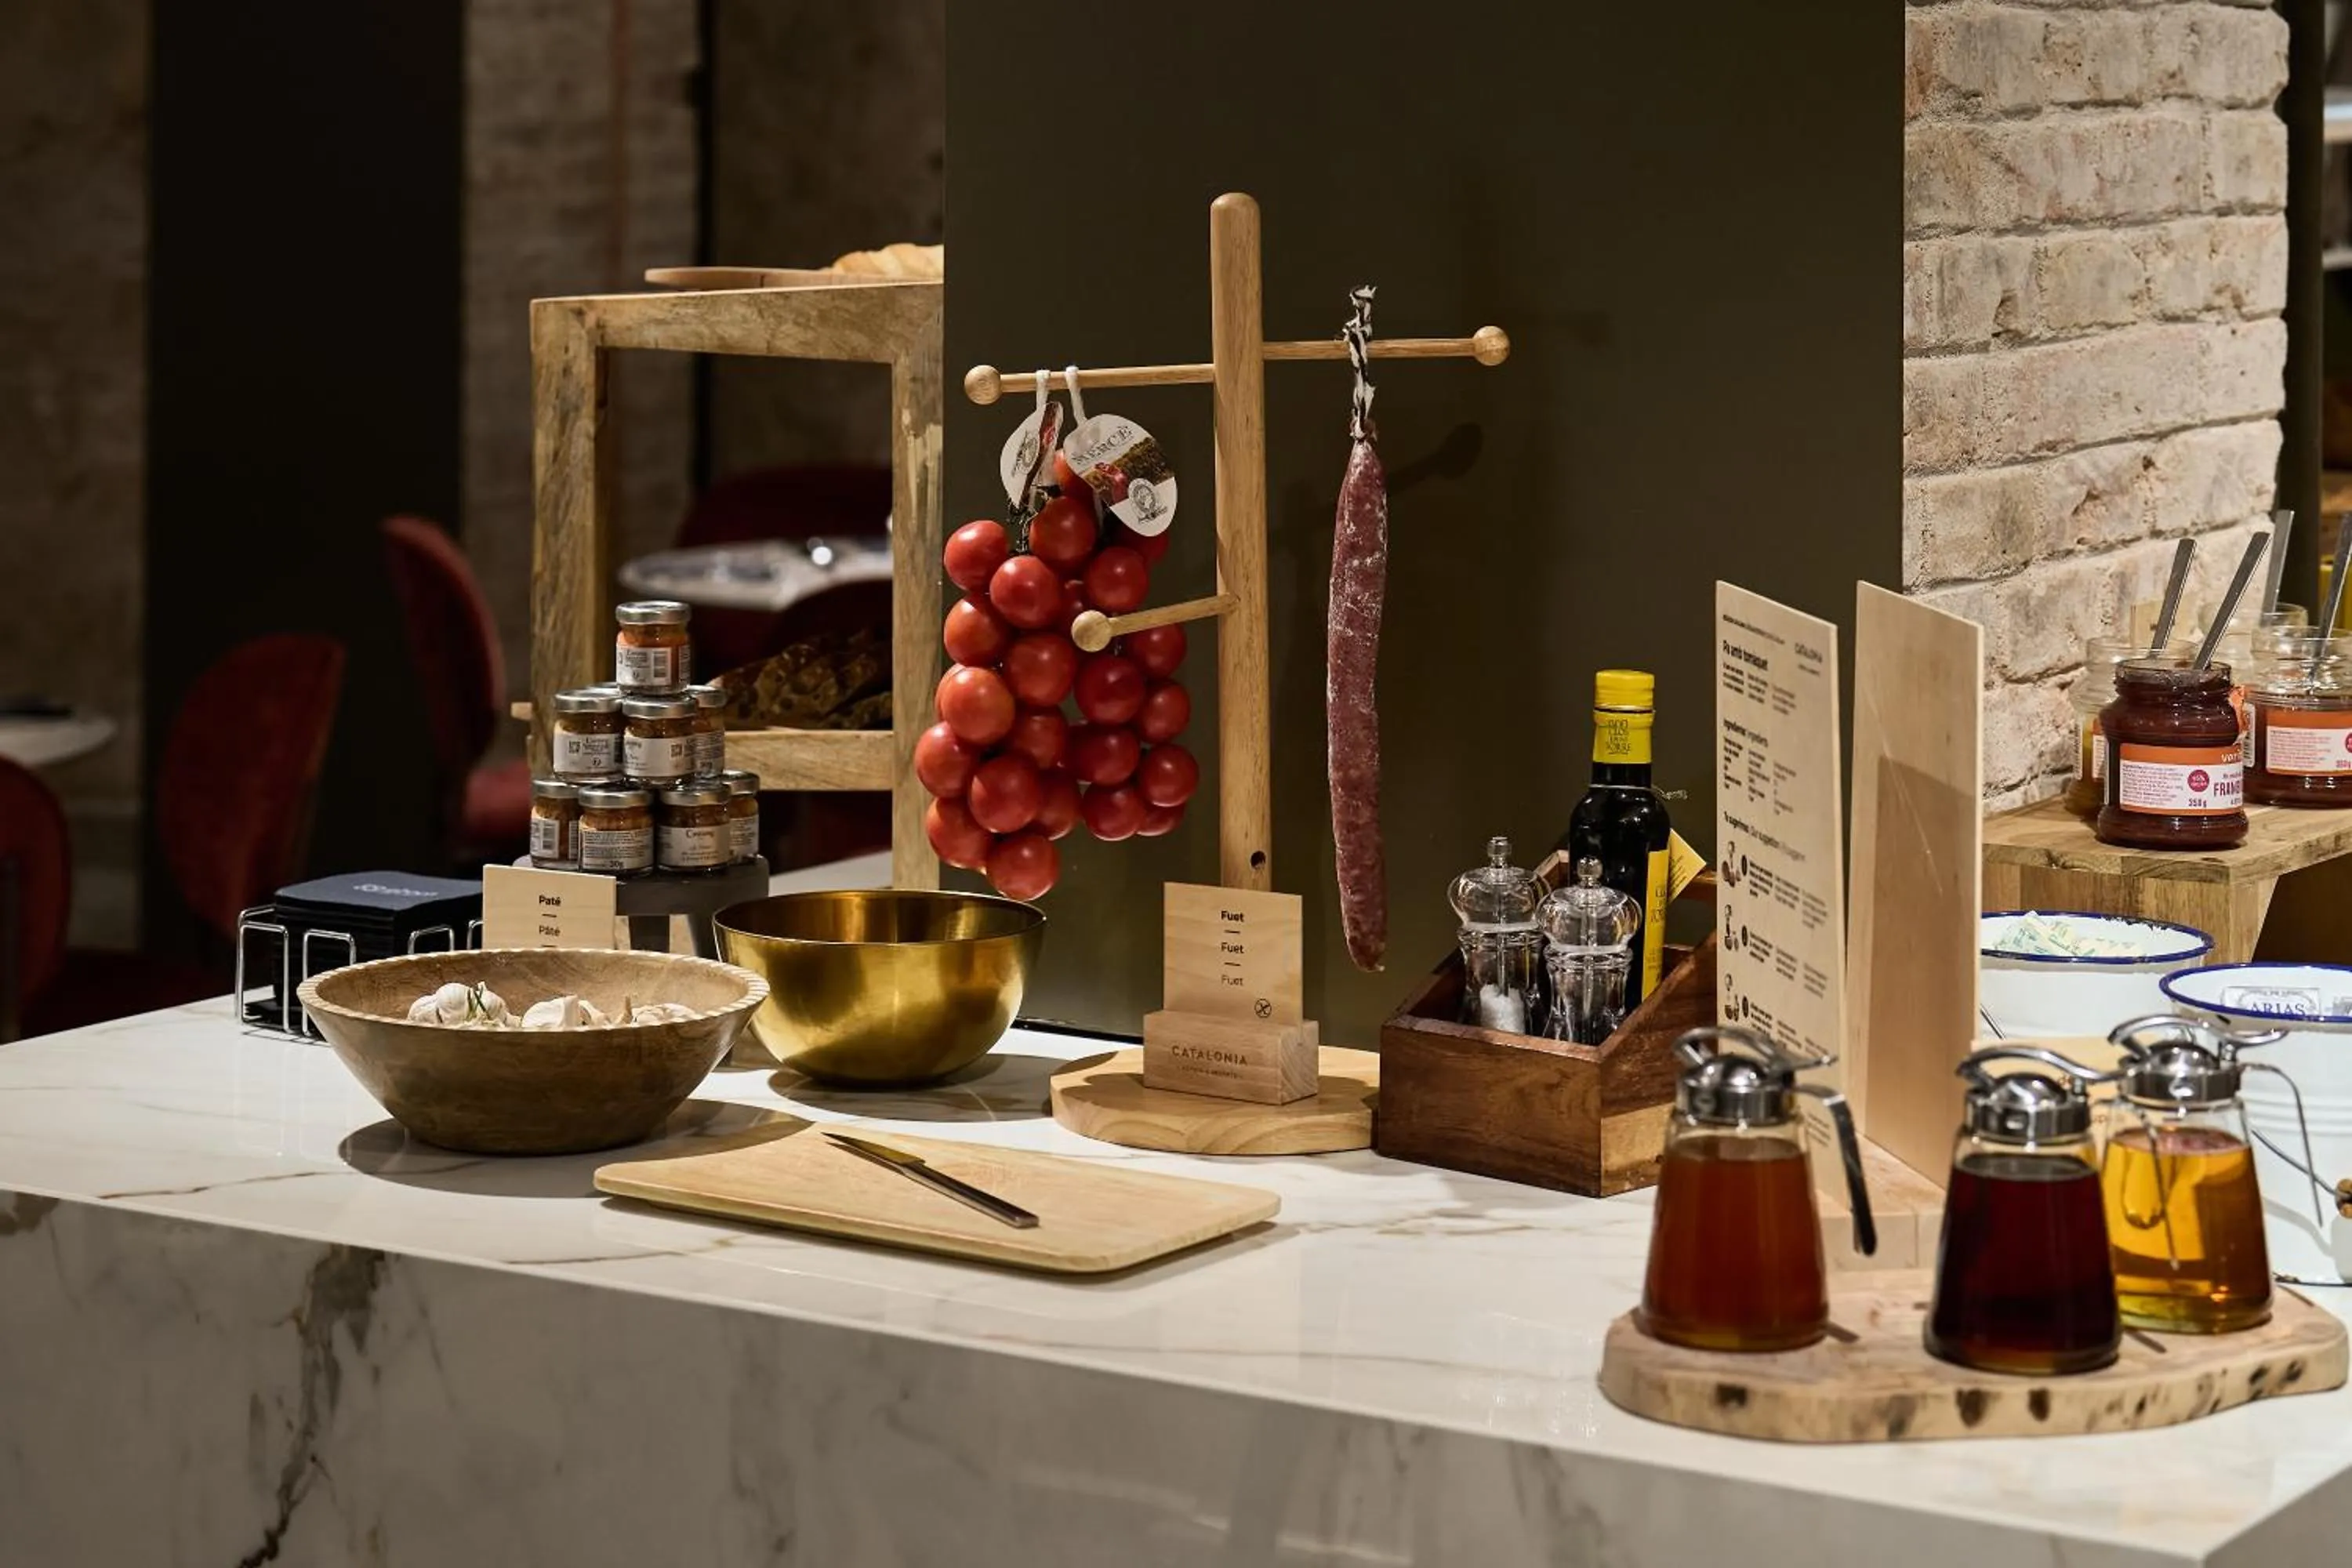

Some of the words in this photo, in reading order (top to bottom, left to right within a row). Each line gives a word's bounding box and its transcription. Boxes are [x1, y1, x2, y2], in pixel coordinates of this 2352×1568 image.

[539, 895, 561, 907] Paté
[1221, 910, 1244, 924] Fuet
[1221, 942, 1244, 955] Fuet
[1221, 974, 1243, 987] Fuet
[2251, 1002, 2305, 1016] ARIAS
[1171, 1044, 1247, 1066] CATALONIA
